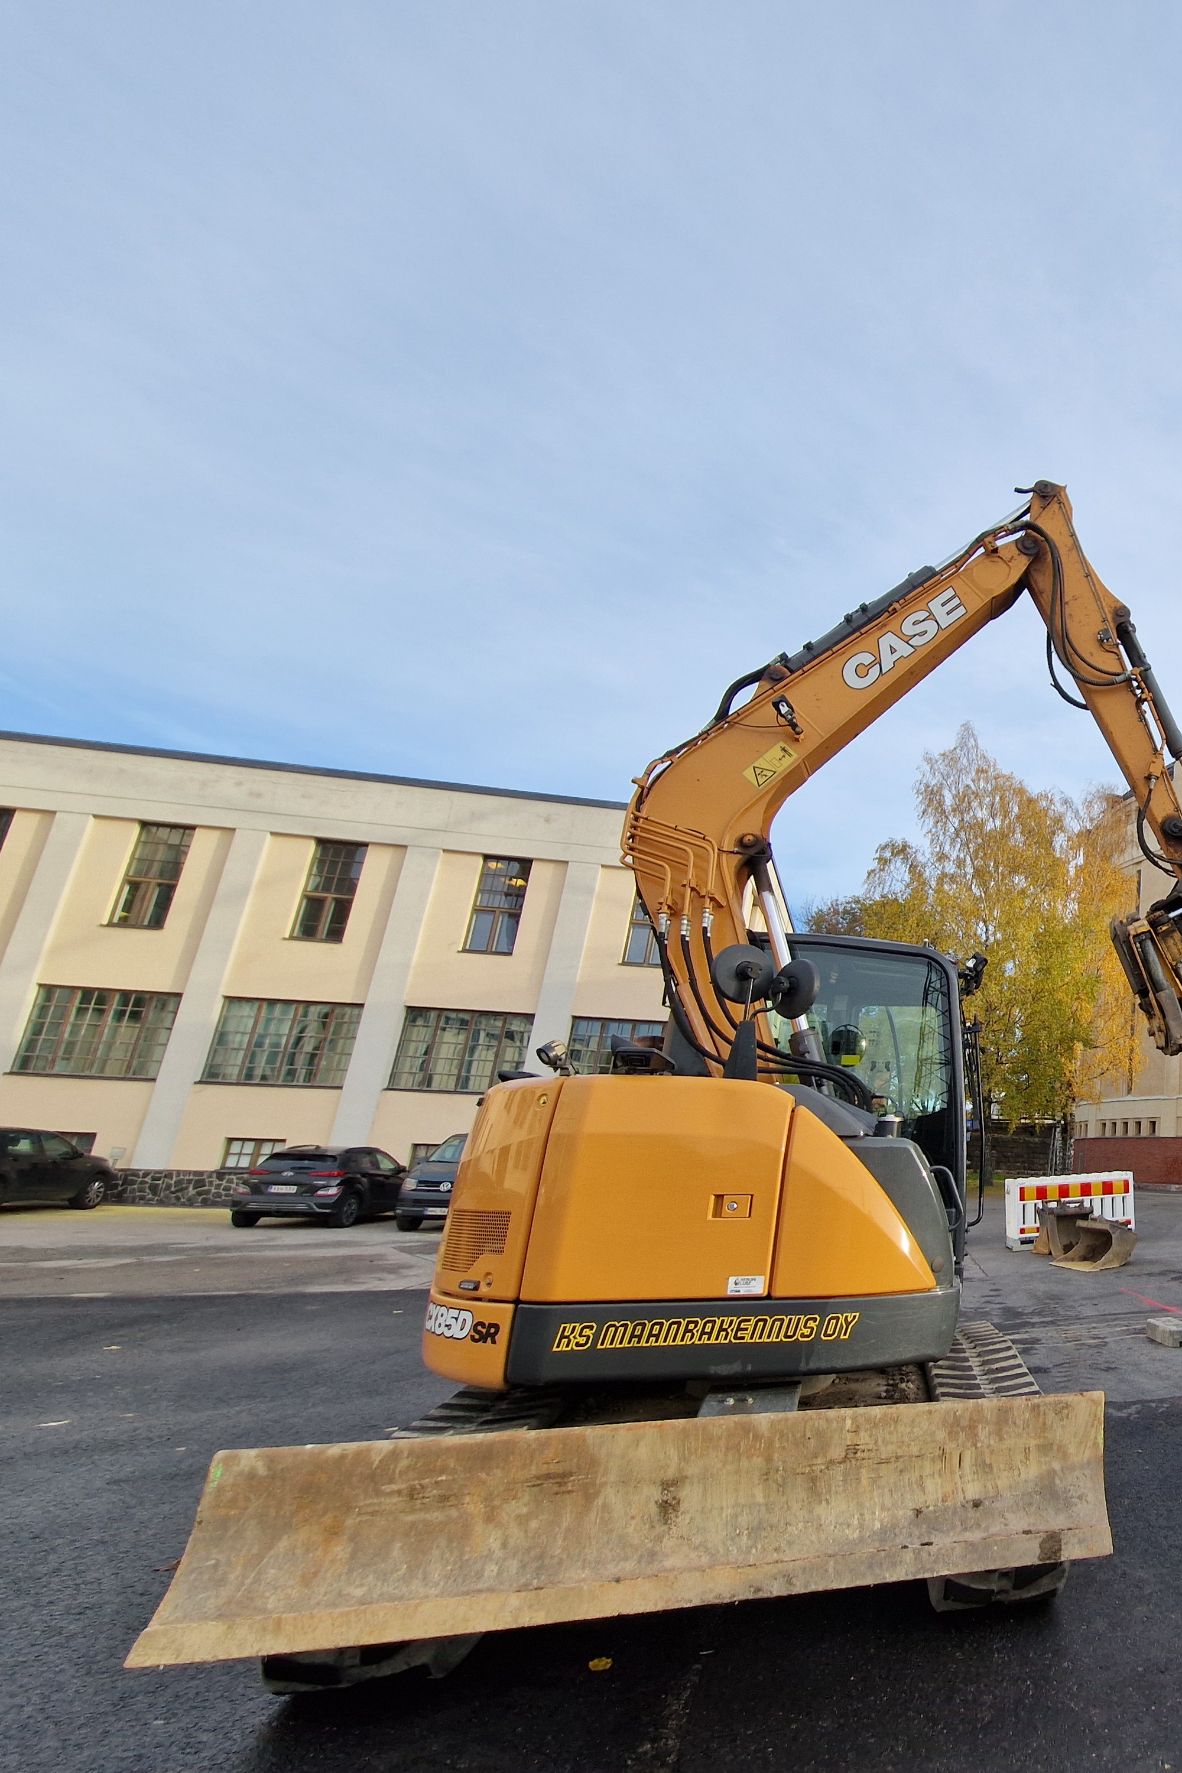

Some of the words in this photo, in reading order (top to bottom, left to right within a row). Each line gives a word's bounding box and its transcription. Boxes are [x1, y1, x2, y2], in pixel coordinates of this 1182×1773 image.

[842, 585, 967, 690] CASE
[470, 1321, 500, 1344] SR
[552, 1322, 597, 1351] KS
[596, 1313, 819, 1350] MAANRAKENNUS
[820, 1312, 860, 1341] OY
